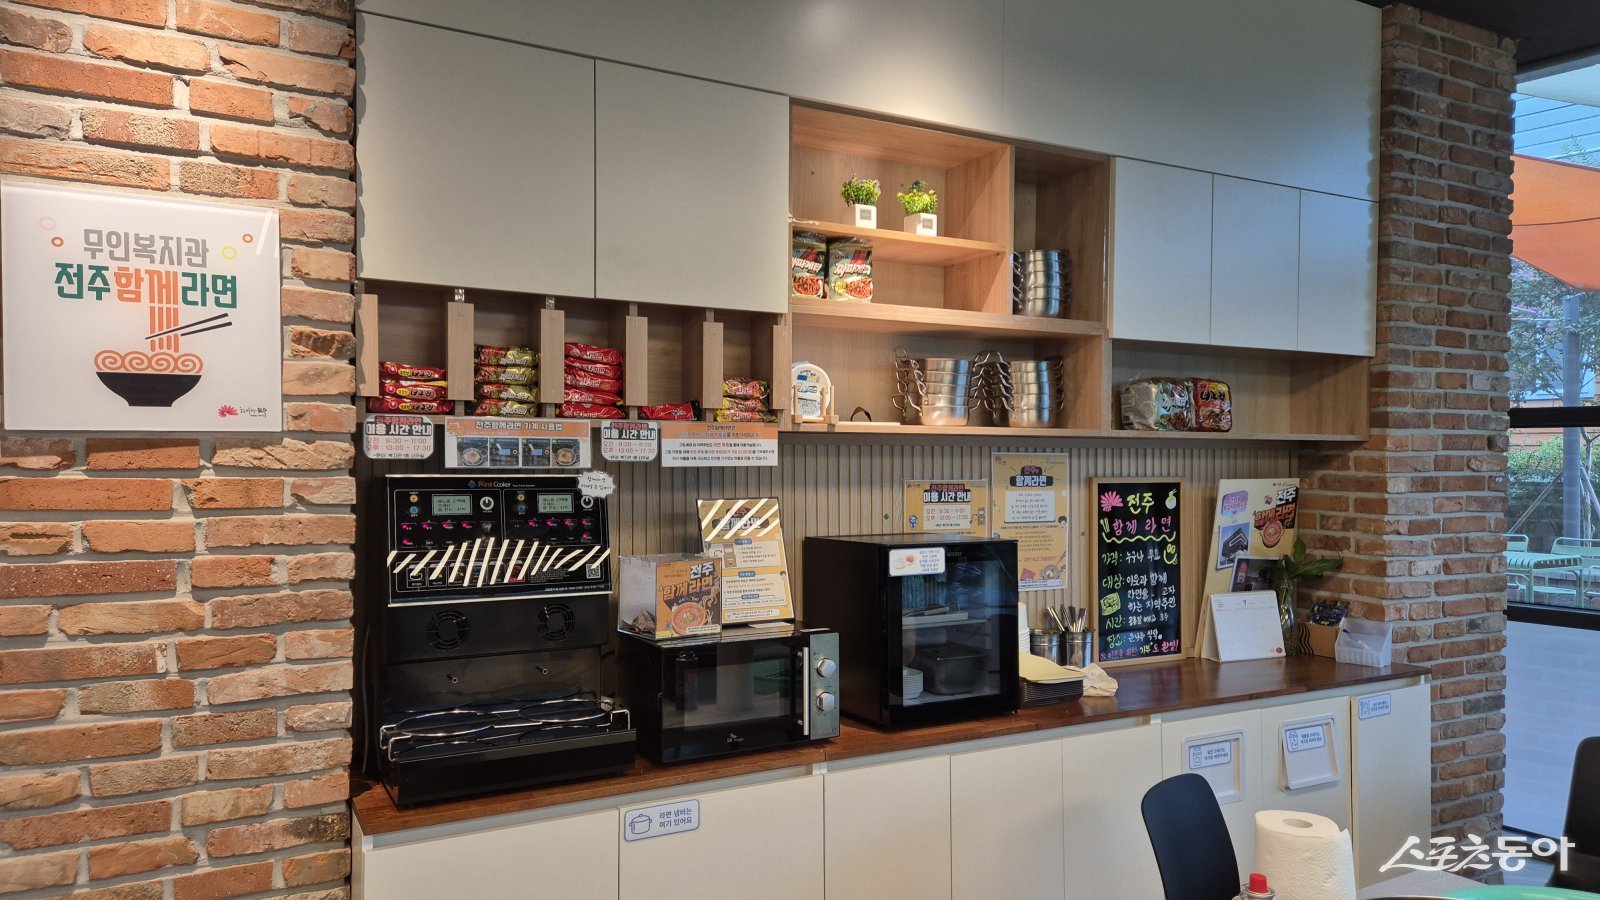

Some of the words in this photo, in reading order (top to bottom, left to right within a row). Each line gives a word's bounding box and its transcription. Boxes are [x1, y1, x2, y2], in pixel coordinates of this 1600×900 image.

[83, 228, 209, 268] 무인복지관
[54, 262, 238, 309] 전주함께라면
[366, 423, 387, 435] 이용
[389, 424, 411, 435] 시간
[411, 424, 432, 436] 안내
[524, 422, 539, 431] 기계
[540, 423, 563, 431] 사용법
[603, 428, 620, 439] 이용
[621, 429, 639, 439] 시간
[640, 429, 656, 440] 안내
[1015, 475, 1047, 487] 함께라면
[923, 491, 939, 502] 이용
[940, 491, 956, 502] 시간
[956, 491, 972, 502] 안내
[1126, 492, 1155, 514] 전주
[1276, 486, 1297, 506] 전주
[1112, 518, 1137, 536] 함께
[1144, 515, 1172, 534] 라면
[1125, 550, 1144, 564] 누구나
[1147, 548, 1161, 563] 무료
[690, 561, 714, 580] 전주
[1126, 573, 1148, 587] 이웃과
[1149, 571, 1168, 586] 함께
[1127, 587, 1149, 600] 라면을
[1127, 600, 1143, 613] 하는
[1146, 595, 1176, 611] 지역주민
[659, 811, 672, 819] 라면
[673, 808, 692, 817] 냄비는
[659, 820, 672, 828] 여기
[673, 817, 692, 826] 있어요
